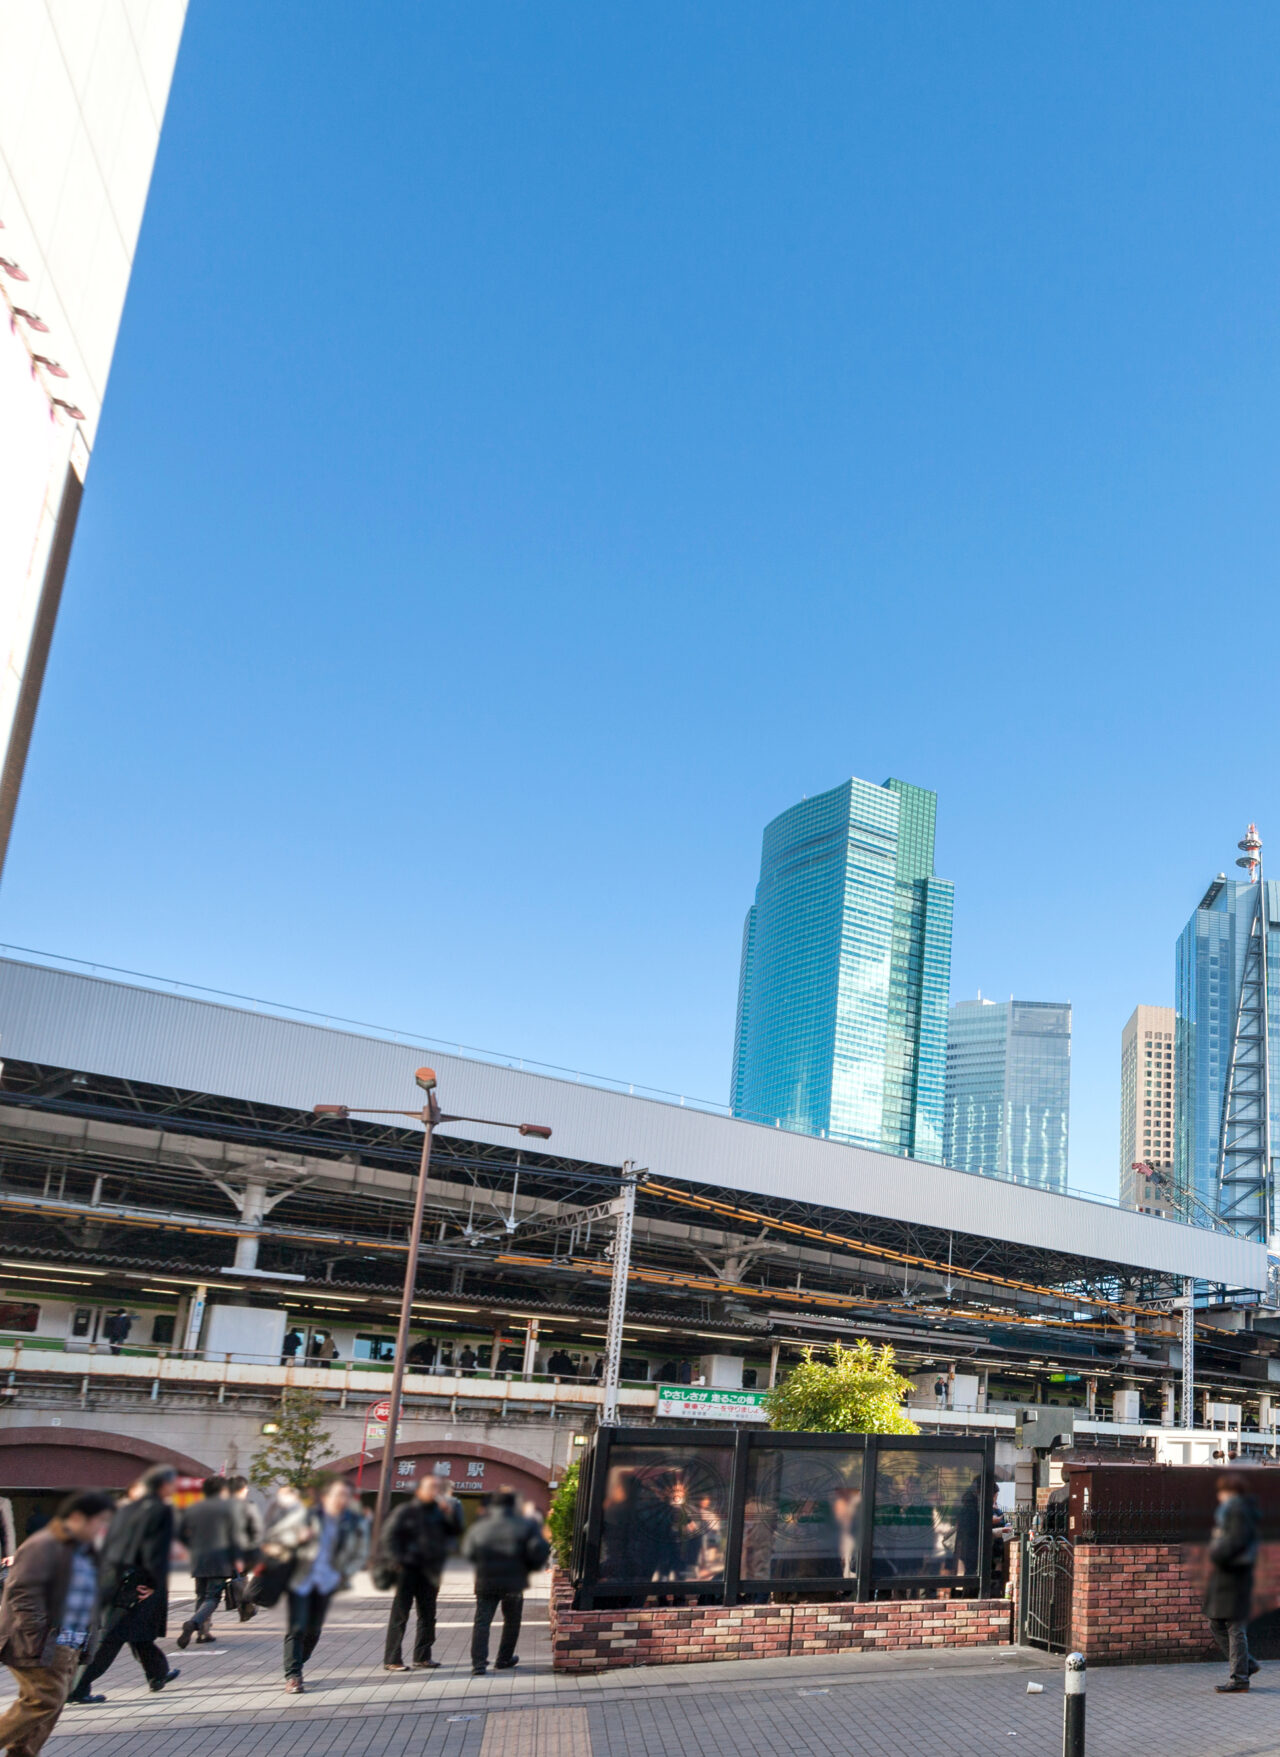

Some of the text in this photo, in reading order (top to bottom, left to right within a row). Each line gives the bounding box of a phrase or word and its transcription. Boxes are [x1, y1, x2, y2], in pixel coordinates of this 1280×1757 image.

[662, 1390, 708, 1402] やさしさが
[396, 1460, 486, 1478] 新橋駅
